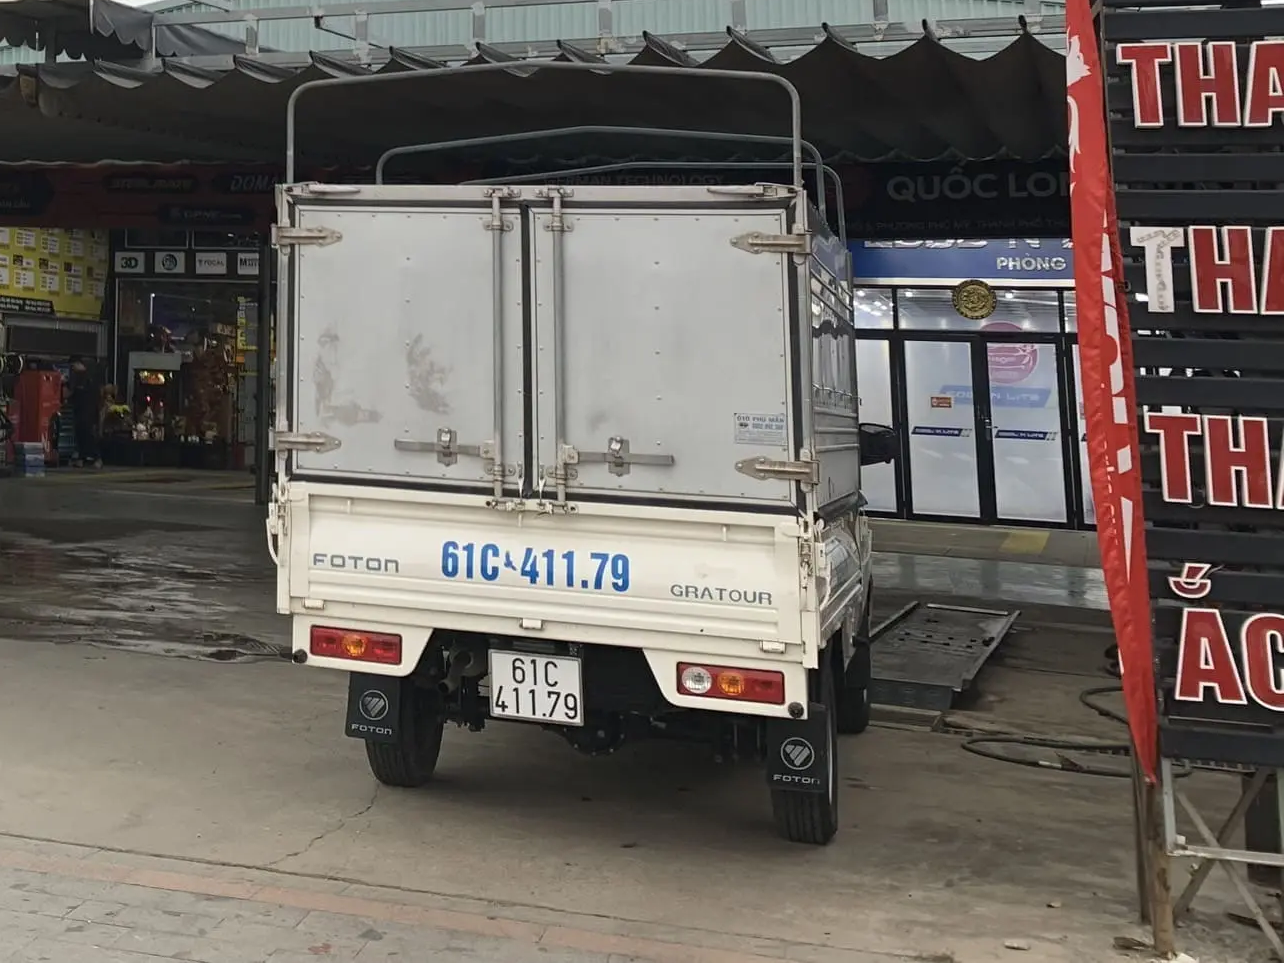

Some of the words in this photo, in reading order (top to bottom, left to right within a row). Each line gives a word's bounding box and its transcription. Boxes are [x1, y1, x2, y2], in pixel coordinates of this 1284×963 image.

[886, 160, 999, 202] QUỐC
[1008, 172, 1069, 198] LO
[996, 252, 1067, 271] PHÒNG
[1143, 412, 1284, 510] TH
[670, 584, 772, 605] GRATOUR
[1167, 561, 1284, 712] ẮC
[512, 658, 558, 687] 61C
[495, 685, 577, 719] 411.79
